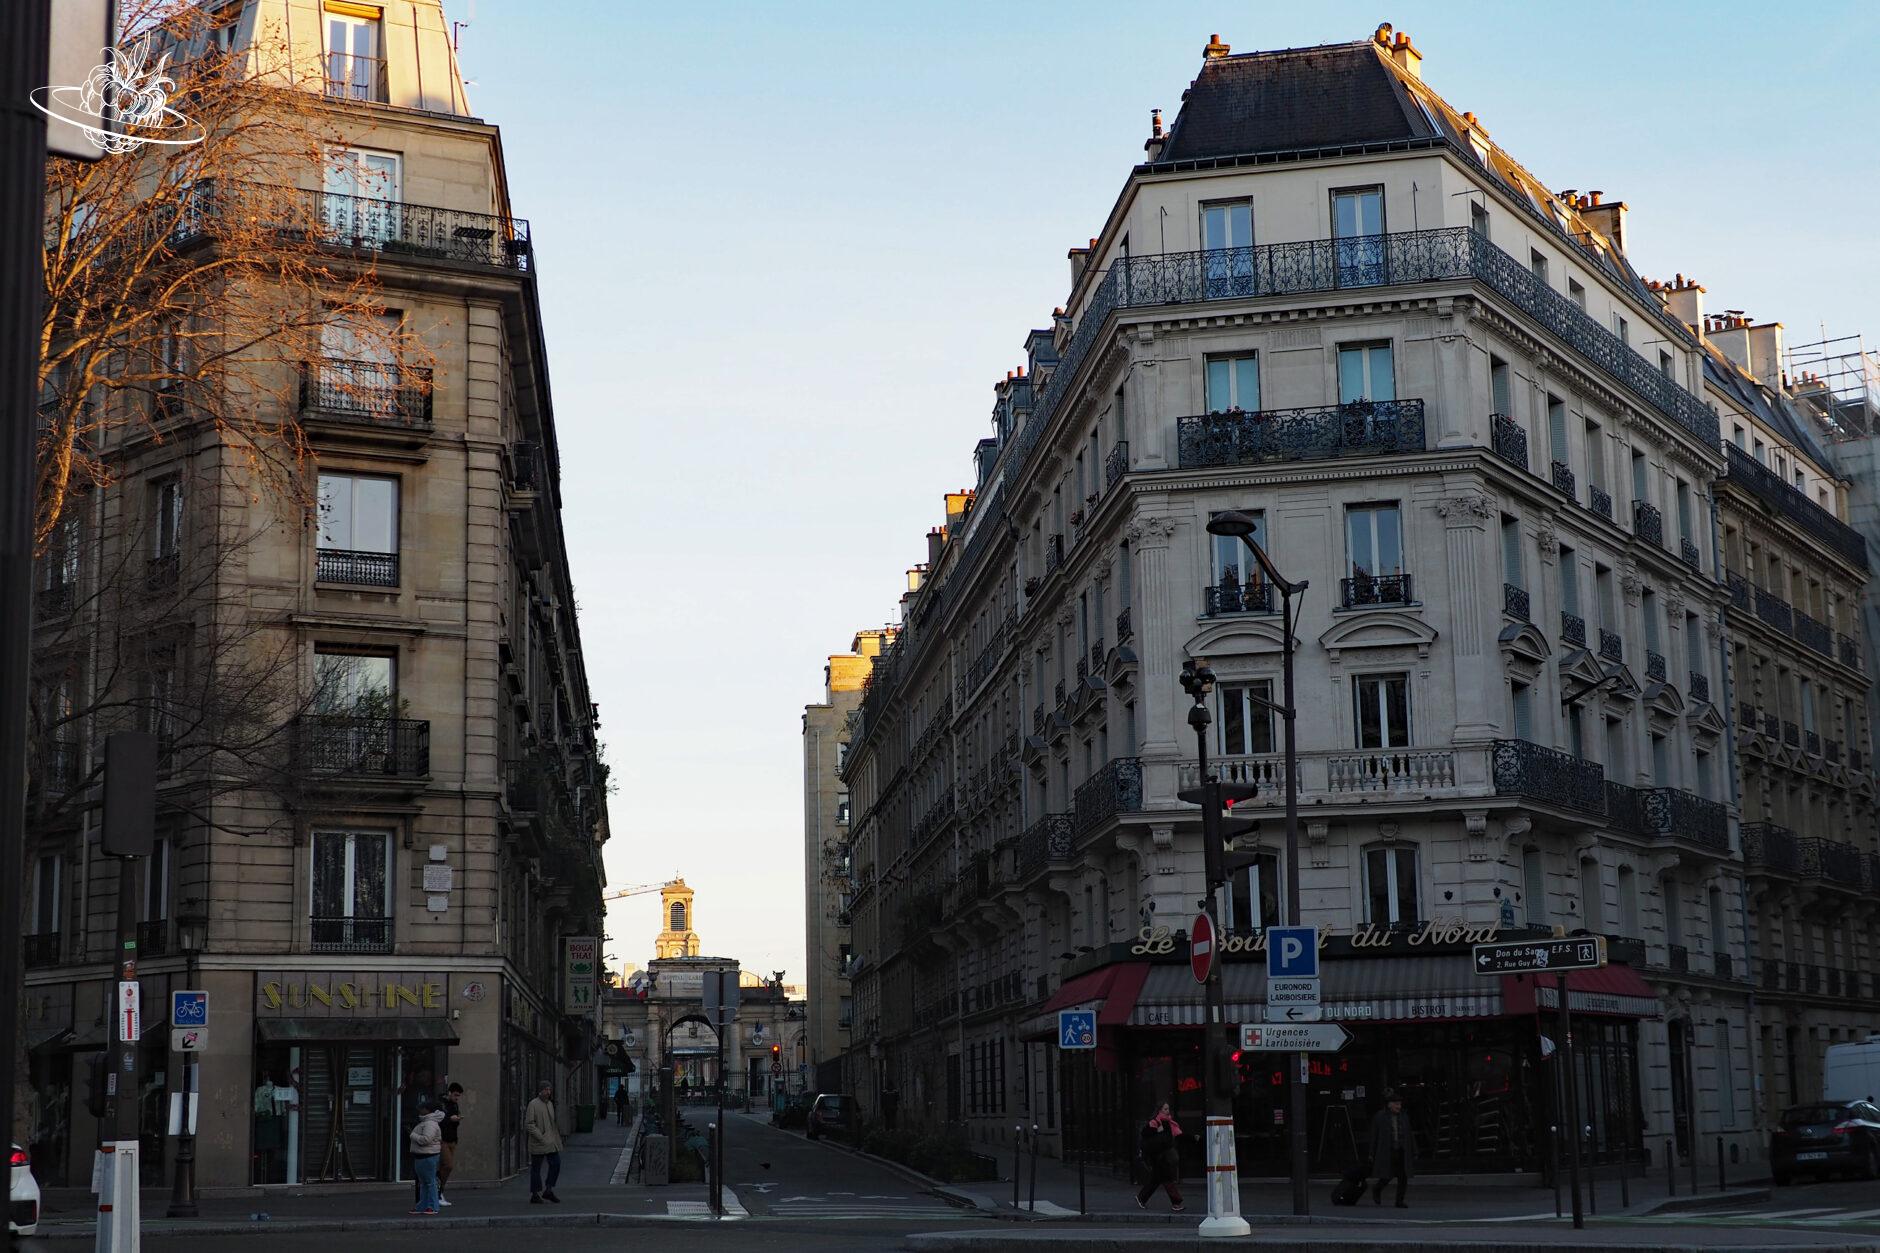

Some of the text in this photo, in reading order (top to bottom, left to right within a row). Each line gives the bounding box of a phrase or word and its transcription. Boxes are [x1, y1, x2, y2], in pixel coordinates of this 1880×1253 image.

[1131, 925, 1177, 956] Le
[1350, 922, 1392, 948] du
[1407, 917, 1502, 947] Nord
[569, 944, 593, 952] BOUA
[1281, 937, 1303, 968] P
[1495, 949, 1511, 958] Don
[1513, 947, 1522, 957] du
[1551, 944, 1573, 954] E.F.S.
[571, 952, 592, 960] THAI
[1504, 960, 1516, 968] Rue
[1274, 983, 1312, 991] EURONORD
[263, 981, 442, 1009] SUNSHINE
[1327, 1007, 1340, 1017] DU
[1344, 1006, 1372, 1017] NORD
[1411, 1004, 1447, 1015] BISTROT
[1265, 1028, 1309, 1038] Urgences
[1265, 1039, 1321, 1048] Lariboisière
